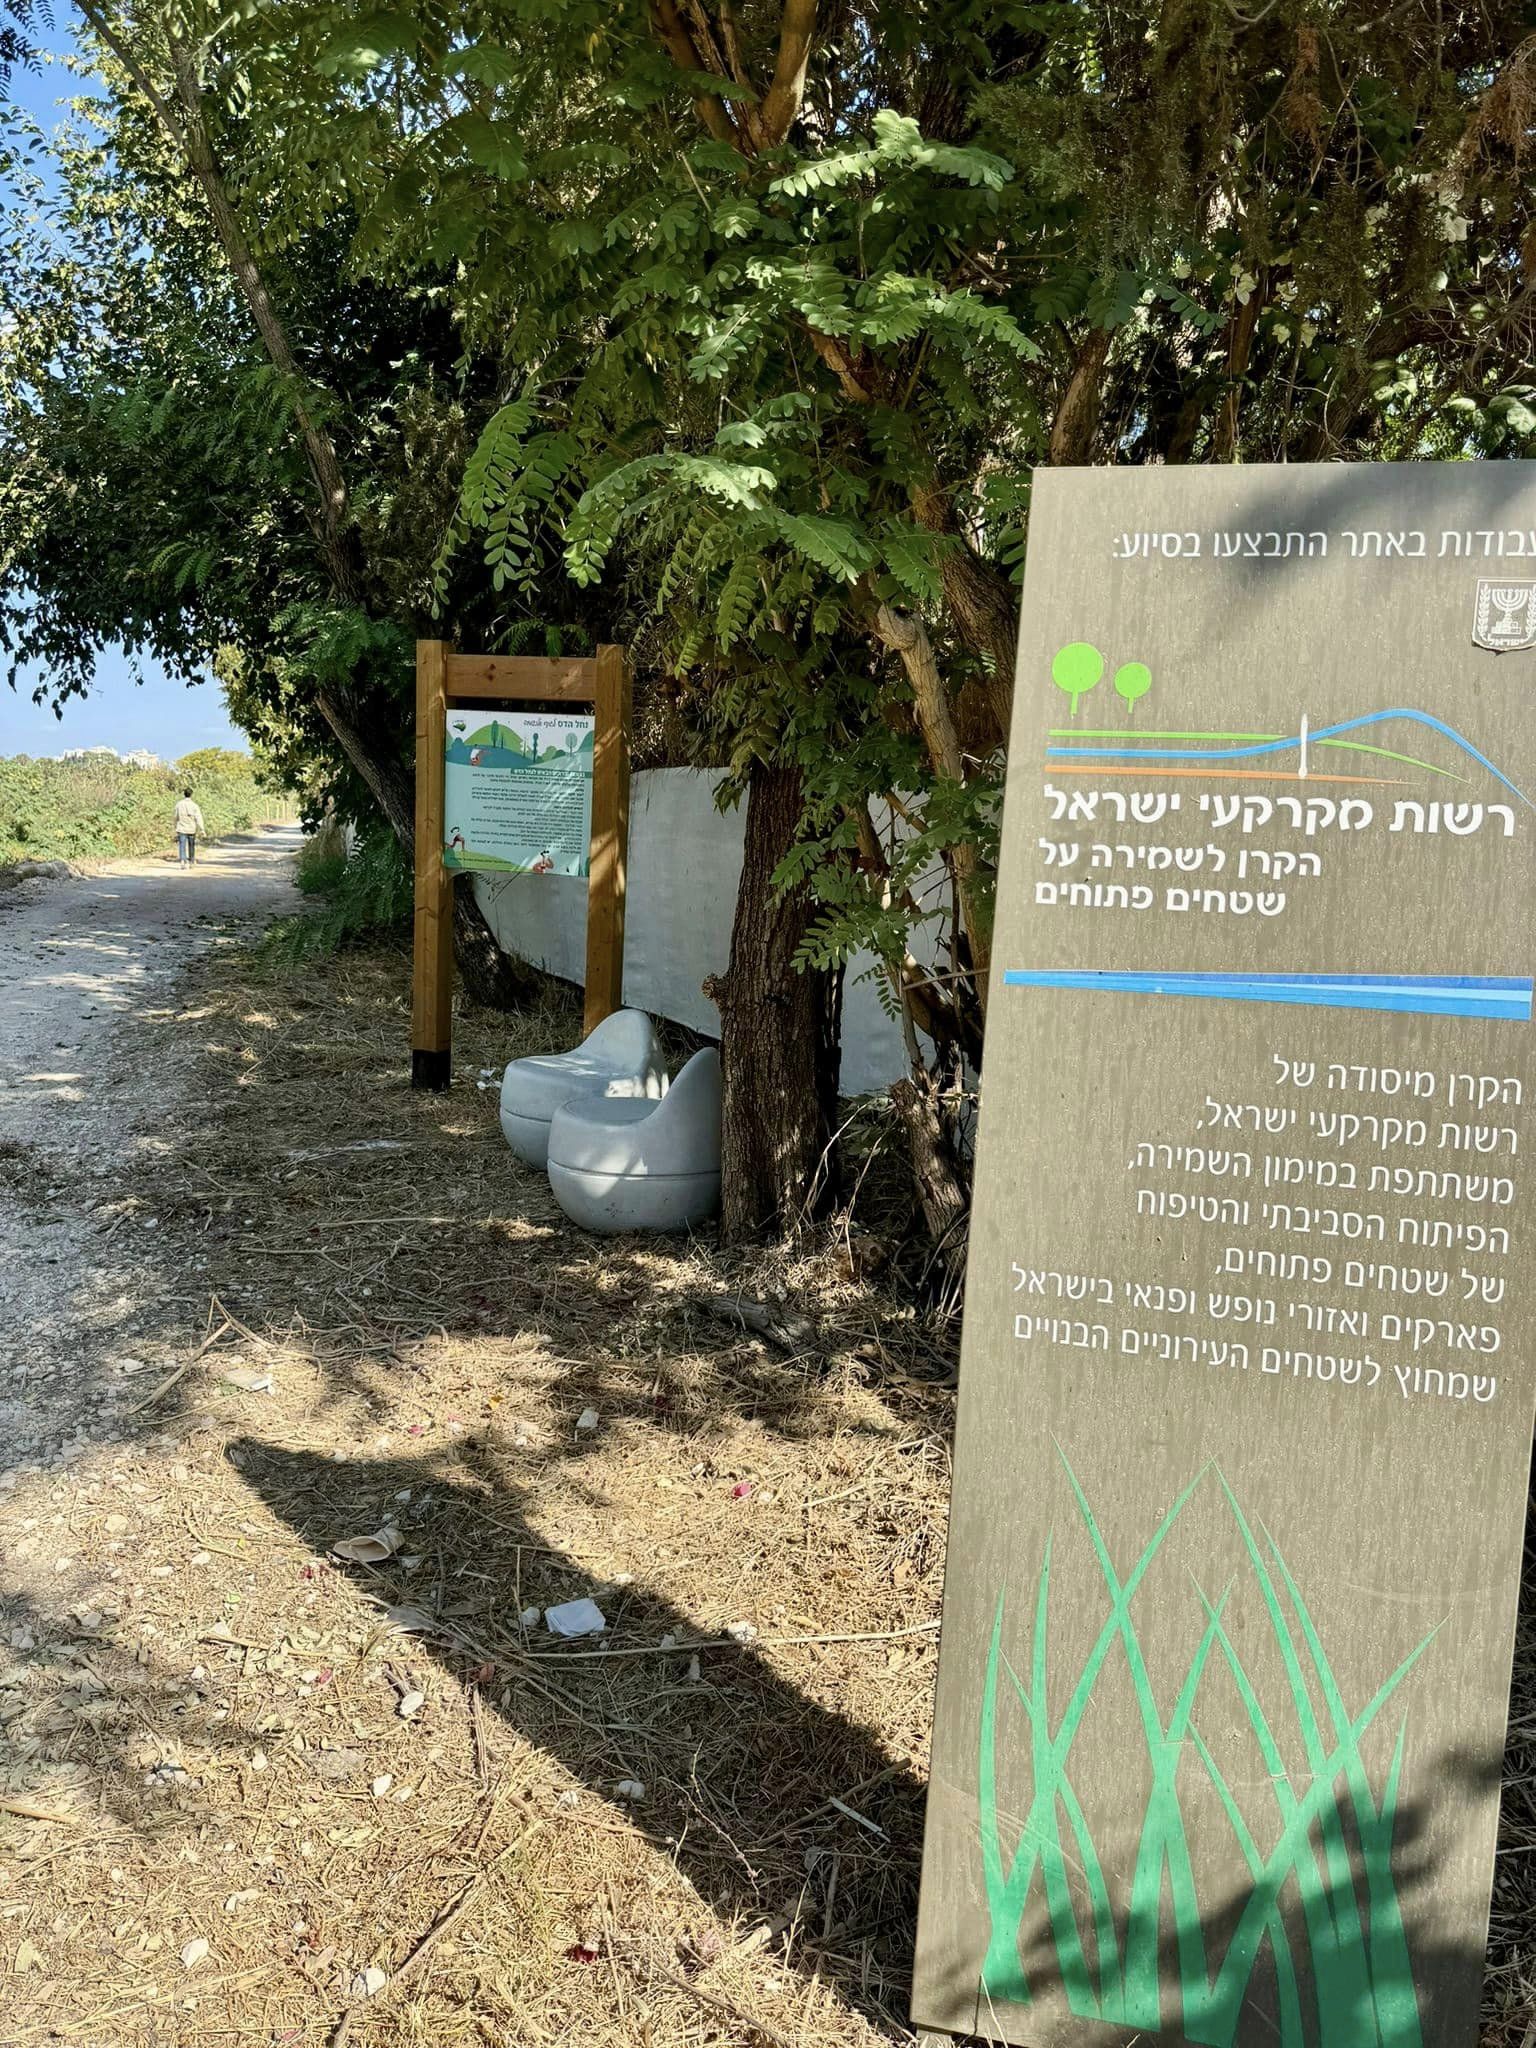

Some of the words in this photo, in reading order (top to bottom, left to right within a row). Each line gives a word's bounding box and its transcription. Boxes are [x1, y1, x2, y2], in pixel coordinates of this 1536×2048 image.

[1112, 533, 1200, 557] בסיוע:
[1214, 532, 1327, 557] התבצעו
[1341, 532, 1425, 557] באתר
[1044, 784, 1180, 823] ישראל
[1197, 794, 1373, 835] מקרקעי
[1389, 801, 1514, 836] רשות
[1039, 838, 1079, 866] על
[1092, 844, 1225, 871] לשמירה
[1238, 850, 1321, 879] הקרן
[1036, 882, 1153, 909] פתוחים
[1167, 888, 1285, 916] שטחים
[1274, 1054, 1315, 1086] של
[1328, 1065, 1434, 1097] מיסודה
[1449, 1074, 1521, 1109] הקרן
[1197, 1096, 1296, 1132] ישראל,
[1310, 1112, 1426, 1150] מקרקעי
[1438, 1123, 1517, 1154] רשות
[1128, 1143, 1250, 1177] השמירה,
[1265, 1156, 1356, 1188] במימון
[1368, 1166, 1513, 1204] משתתפת
[1138, 1190, 1248, 1225] והטיפוח
[1263, 1204, 1384, 1240] הסביבתי
[1399, 1218, 1508, 1254] הפיתוח
[1012, 1262, 1113, 1303] בישראל
[1215, 1248, 1331, 1283] פתוחים,
[1345, 1262, 1448, 1296] שטחים
[1126, 1283, 1195, 1314] ופנאי
[1461, 1268, 1504, 1303] של
[1209, 1293, 1275, 1324] נופש
[1290, 1303, 1367, 1336] ואזורי
[1015, 1315, 1108, 1349] הבנויים
[1382, 1315, 1500, 1352] פארקים
[1122, 1330, 1248, 1369] העירוניים
[1262, 1349, 1380, 1385] לשטחים
[1394, 1365, 1495, 1401] שמחוץ
